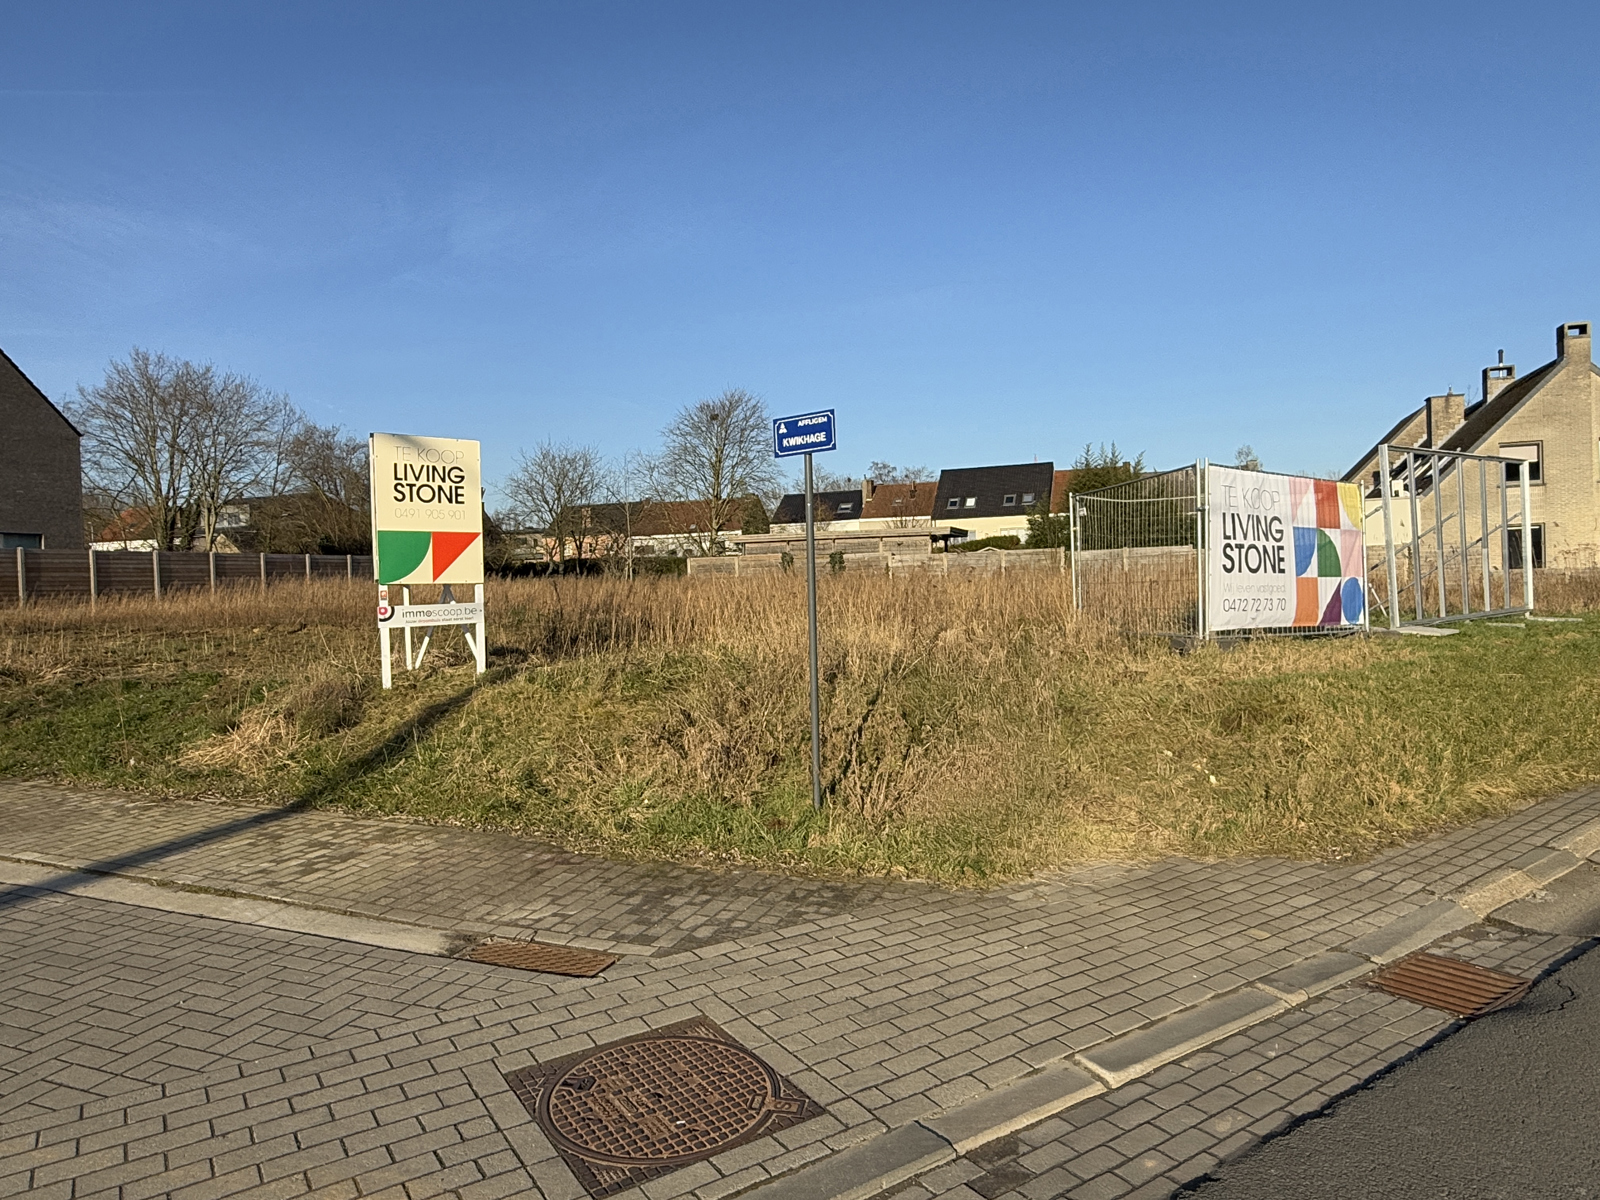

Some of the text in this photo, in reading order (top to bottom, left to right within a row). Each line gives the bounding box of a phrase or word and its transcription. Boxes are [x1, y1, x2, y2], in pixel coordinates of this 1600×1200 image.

[798, 416, 827, 427] AFFLIGEM
[783, 432, 826, 447] KWIKHAGE
[394, 446, 464, 464] TE KOOP
[394, 463, 465, 484] LIVING
[393, 483, 465, 504] STONE
[1221, 485, 1280, 511] TE KOOP
[394, 508, 466, 520] 0491 905 901
[1222, 512, 1284, 543] LIVING
[1222, 543, 1286, 574] STONE
[402, 607, 477, 618] immoscoop.be
[1223, 598, 1287, 612] 0472 72 73 70
